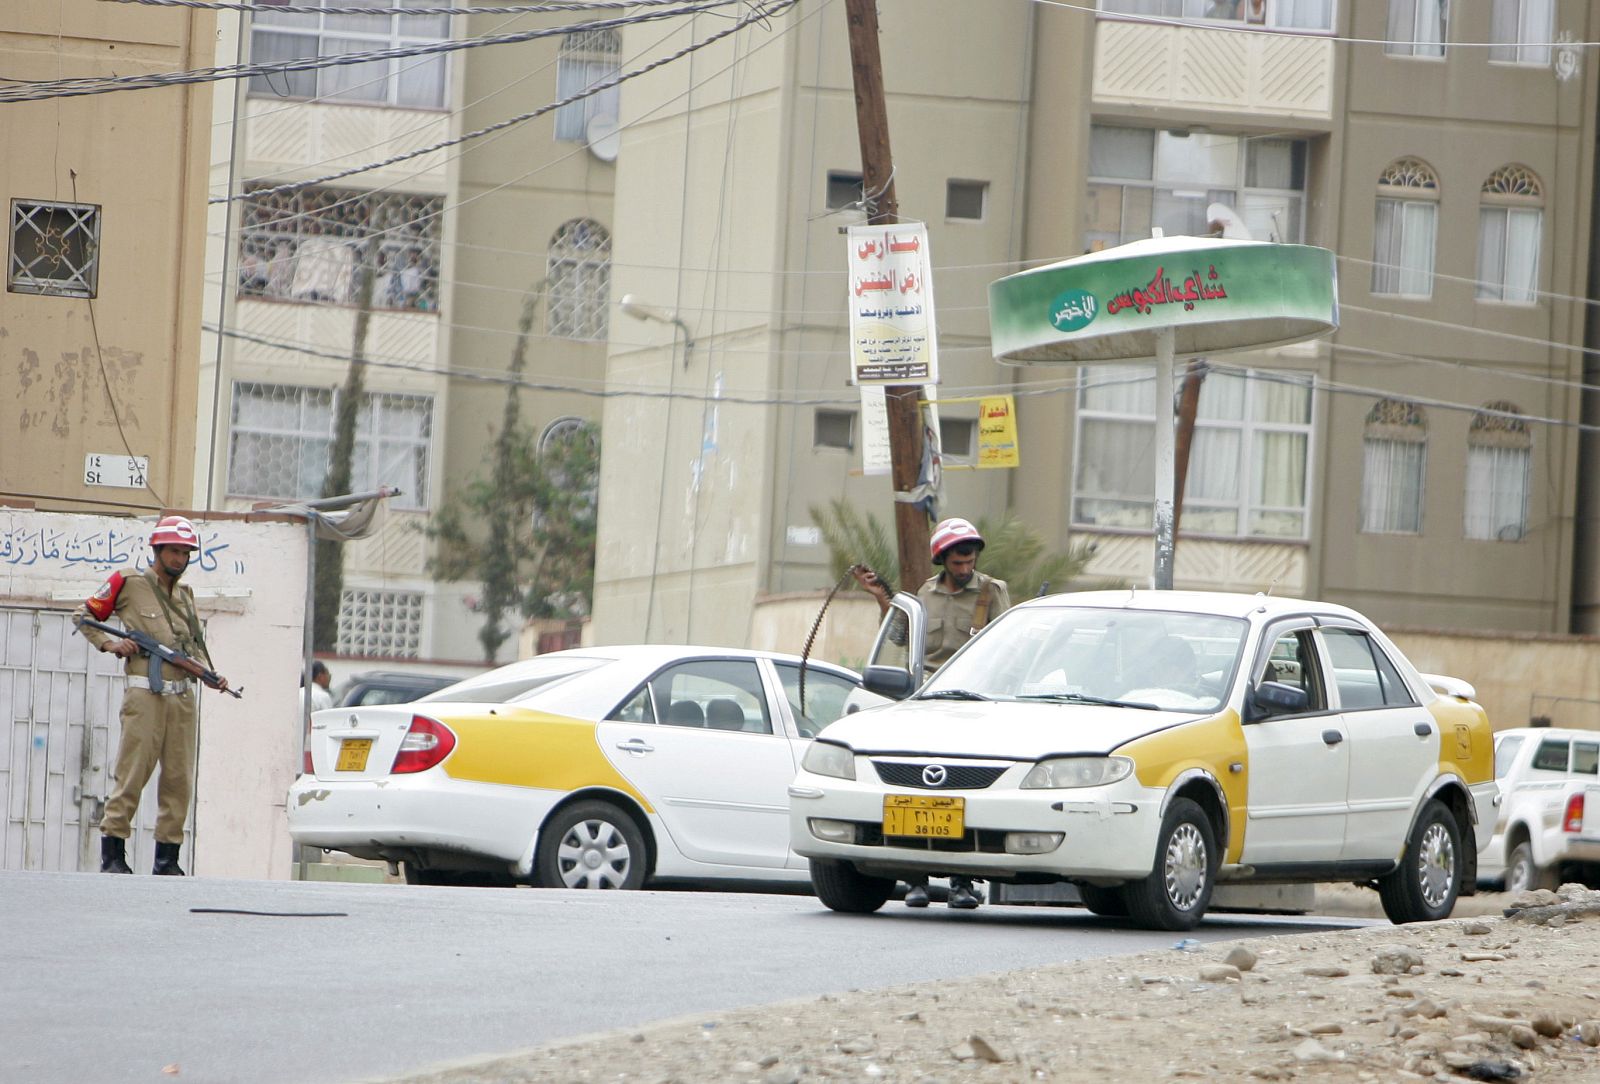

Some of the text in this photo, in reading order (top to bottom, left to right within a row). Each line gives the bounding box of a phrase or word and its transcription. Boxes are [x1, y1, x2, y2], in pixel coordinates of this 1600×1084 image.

[858, 231, 920, 260] مدارس
[1055, 295, 1096, 326] الأخضر
[86, 471, 143, 486] St 14
[914, 810, 952, 823] ٣٦١٠٥
[915, 825, 950, 835] 36105
